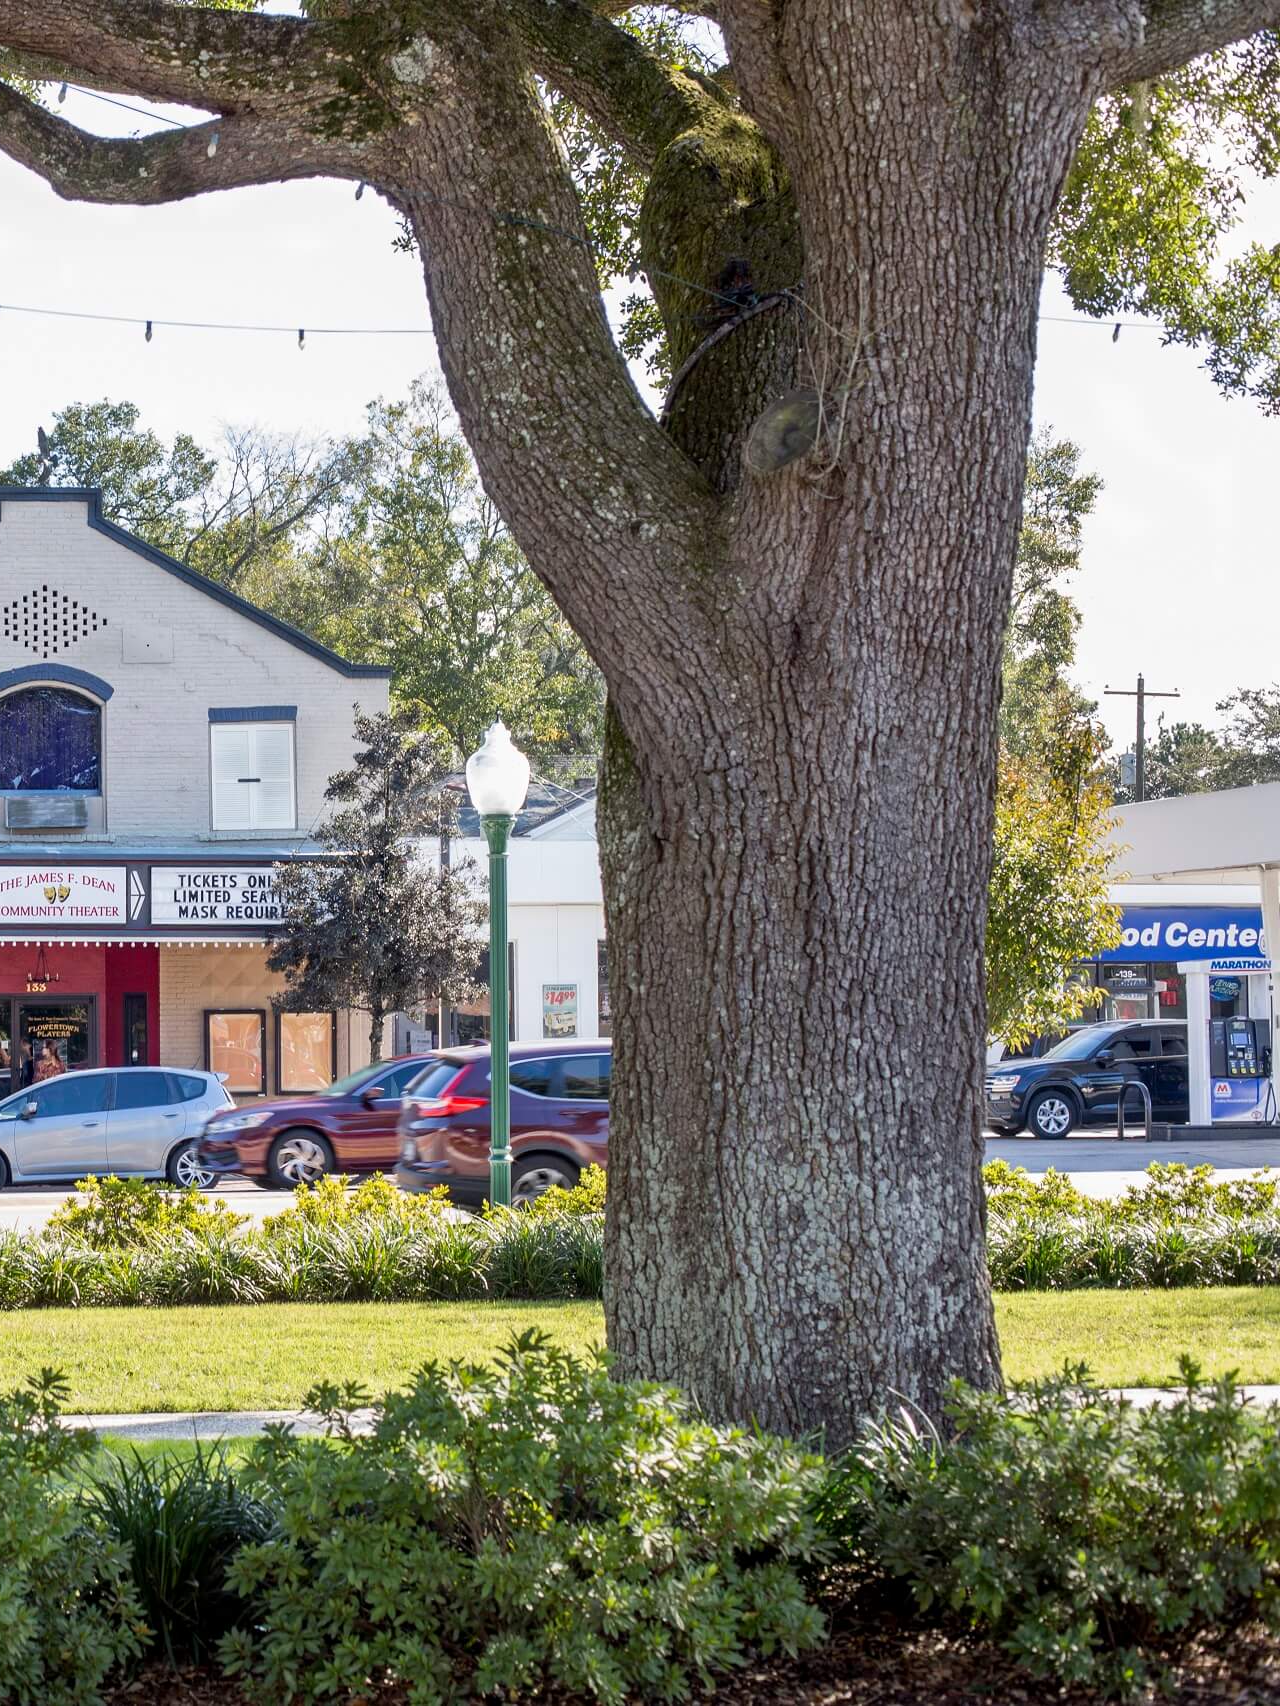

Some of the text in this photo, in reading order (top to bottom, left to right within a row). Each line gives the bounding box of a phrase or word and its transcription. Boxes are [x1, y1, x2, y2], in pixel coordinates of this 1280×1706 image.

[25, 872, 64, 888] JAMES
[68, 873, 78, 884] F.
[82, 875, 115, 893] DEAN
[178, 874, 238, 888] TICKETS
[173, 890, 231, 903] LIMITED
[67, 906, 120, 917] THEATER
[178, 906, 289, 919] MASK REQUIRE
[1121, 922, 1161, 947] od
[1210, 960, 1272, 969] MARATHON
[25, 983, 47, 992] 133
[28, 1023, 80, 1033] FLOWERTOWN
